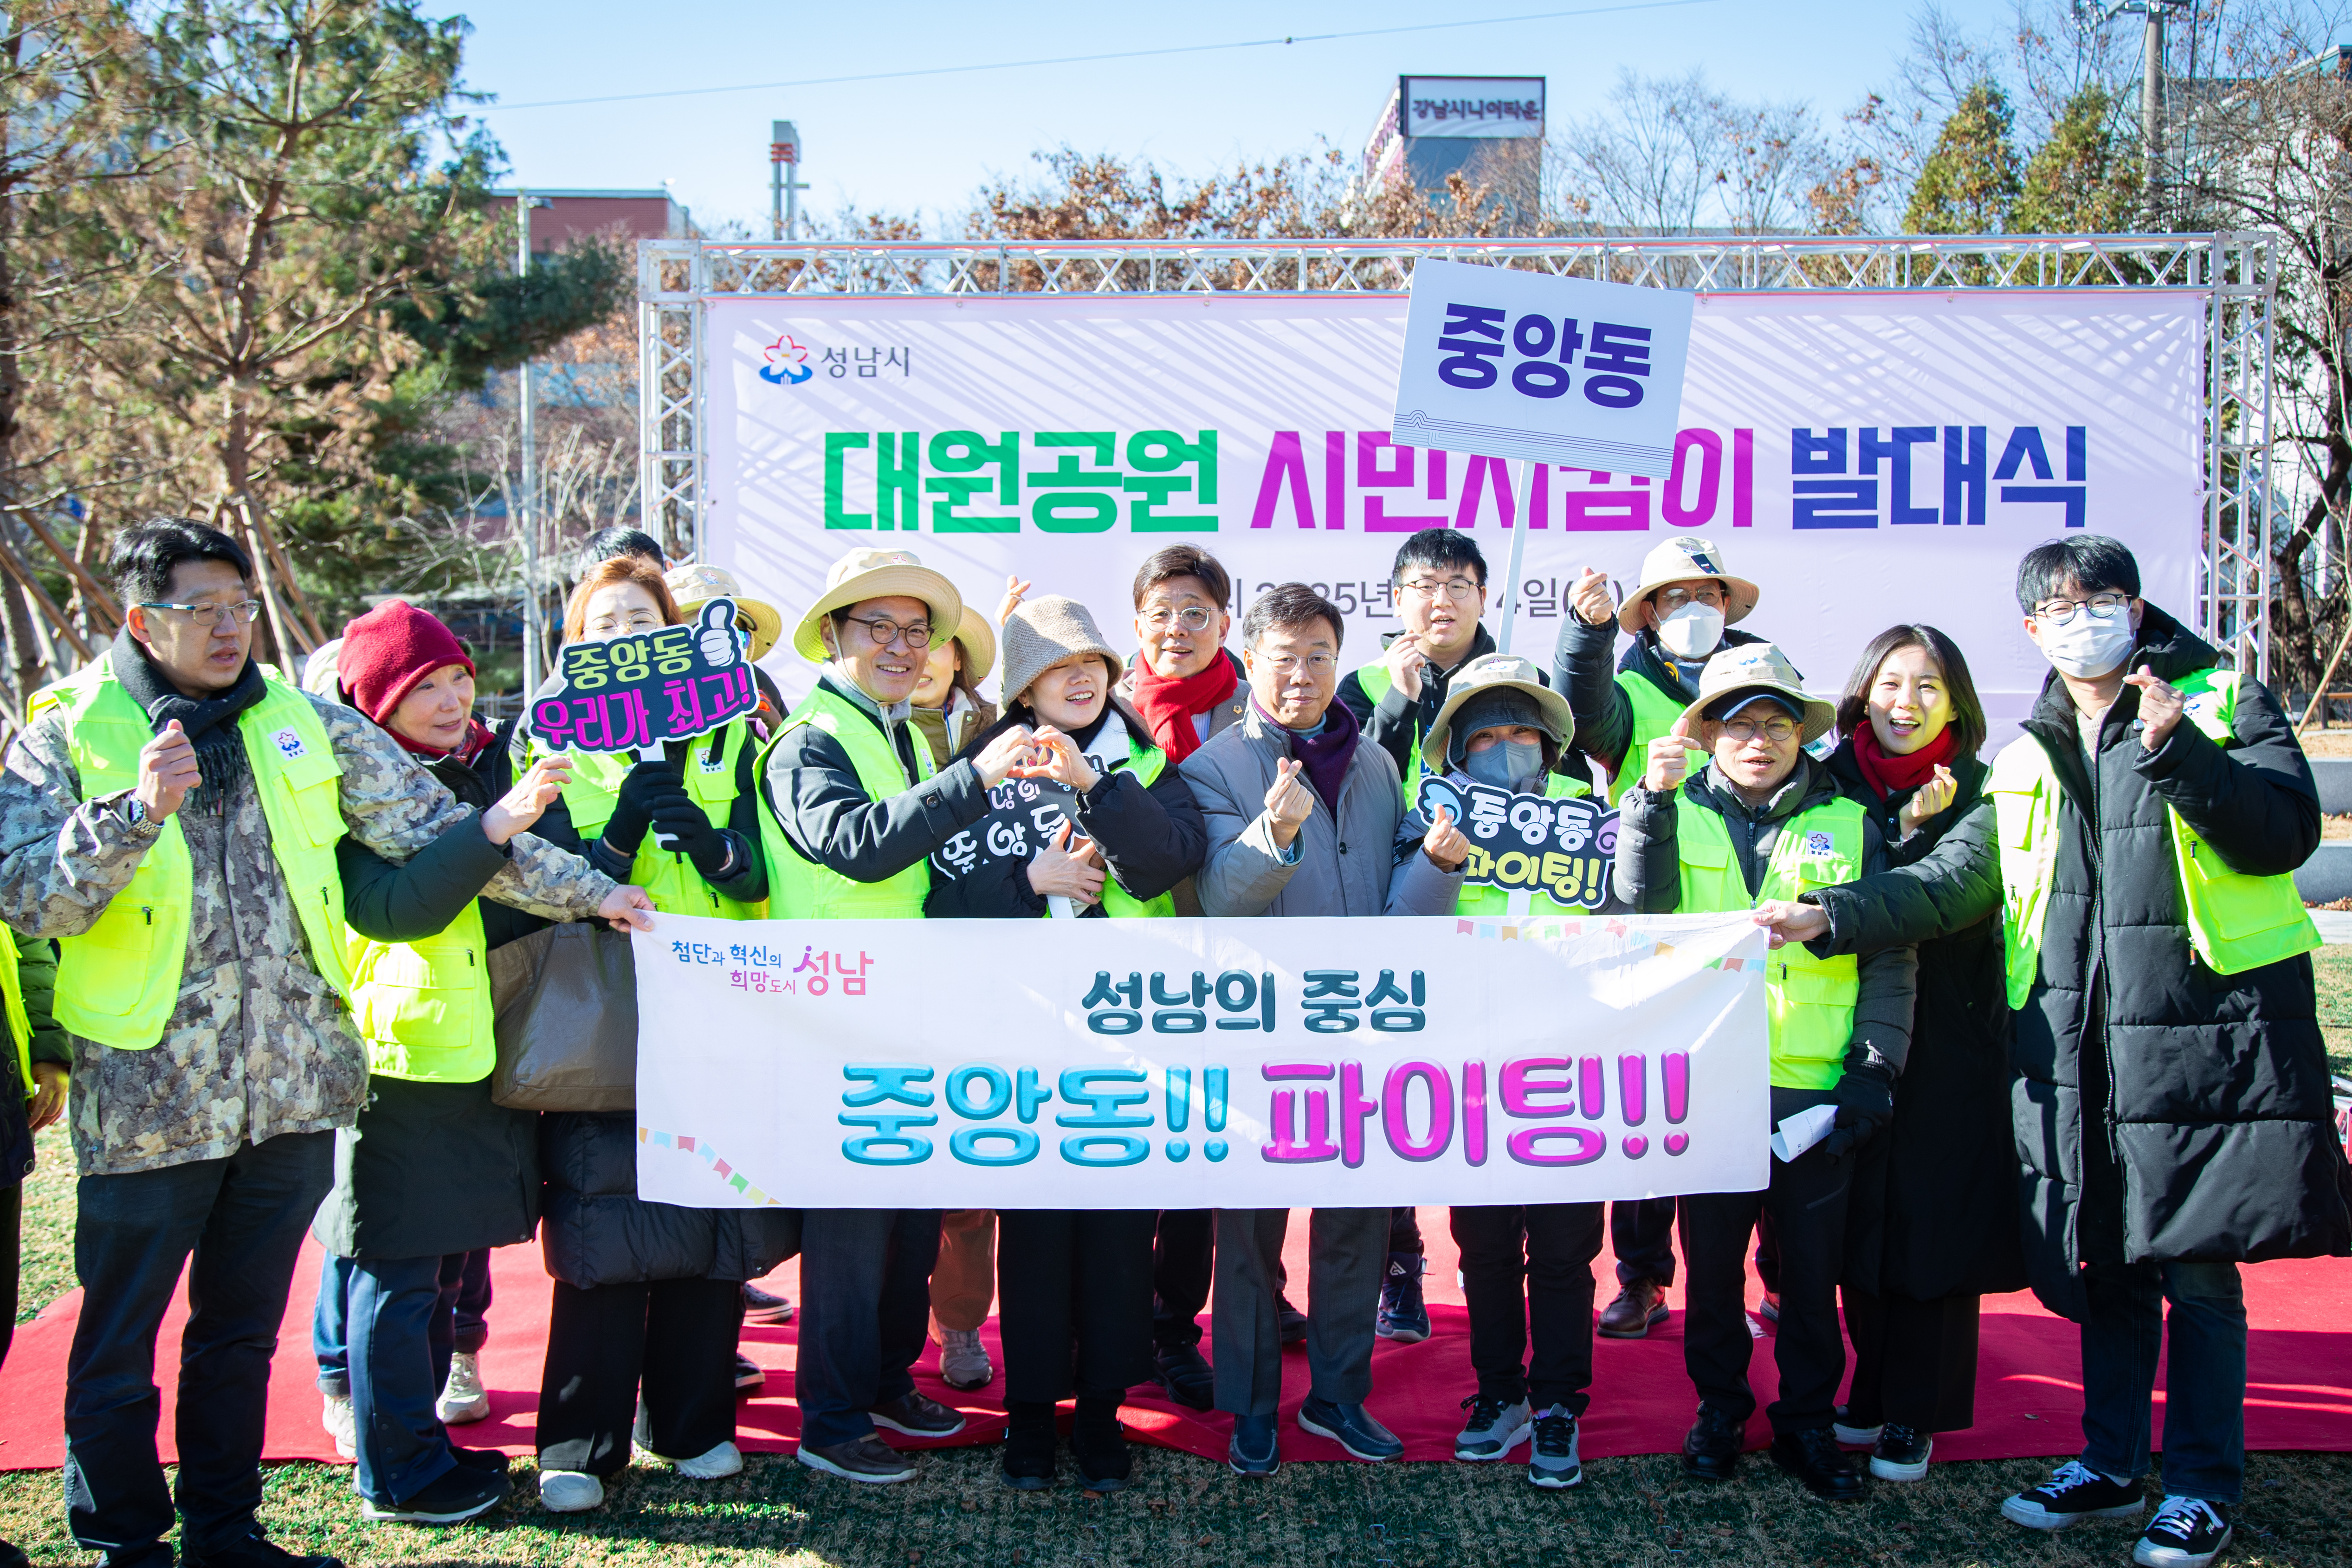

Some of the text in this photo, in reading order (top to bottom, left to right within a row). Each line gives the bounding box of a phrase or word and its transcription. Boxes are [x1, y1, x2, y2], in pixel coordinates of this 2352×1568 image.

[1412, 98, 1539, 120] 강남시니어타운
[821, 346, 909, 378] 성남시
[1438, 303, 1652, 408] 중앙동
[824, 430, 1219, 533] 대원공원
[1792, 426, 2086, 529] 발대식
[568, 632, 693, 690] 중앙동
[536, 667, 750, 748] 우리가 최고!
[1469, 791, 1593, 852] 중앙동
[672, 940, 781, 968] 첨단과 혁신의
[730, 970, 796, 995] 희망도시
[793, 945, 874, 996] 성남
[1081, 968, 1426, 1035] 성남의 중심
[838, 1047, 1690, 1169] 중앙동!! 파이팅!!
